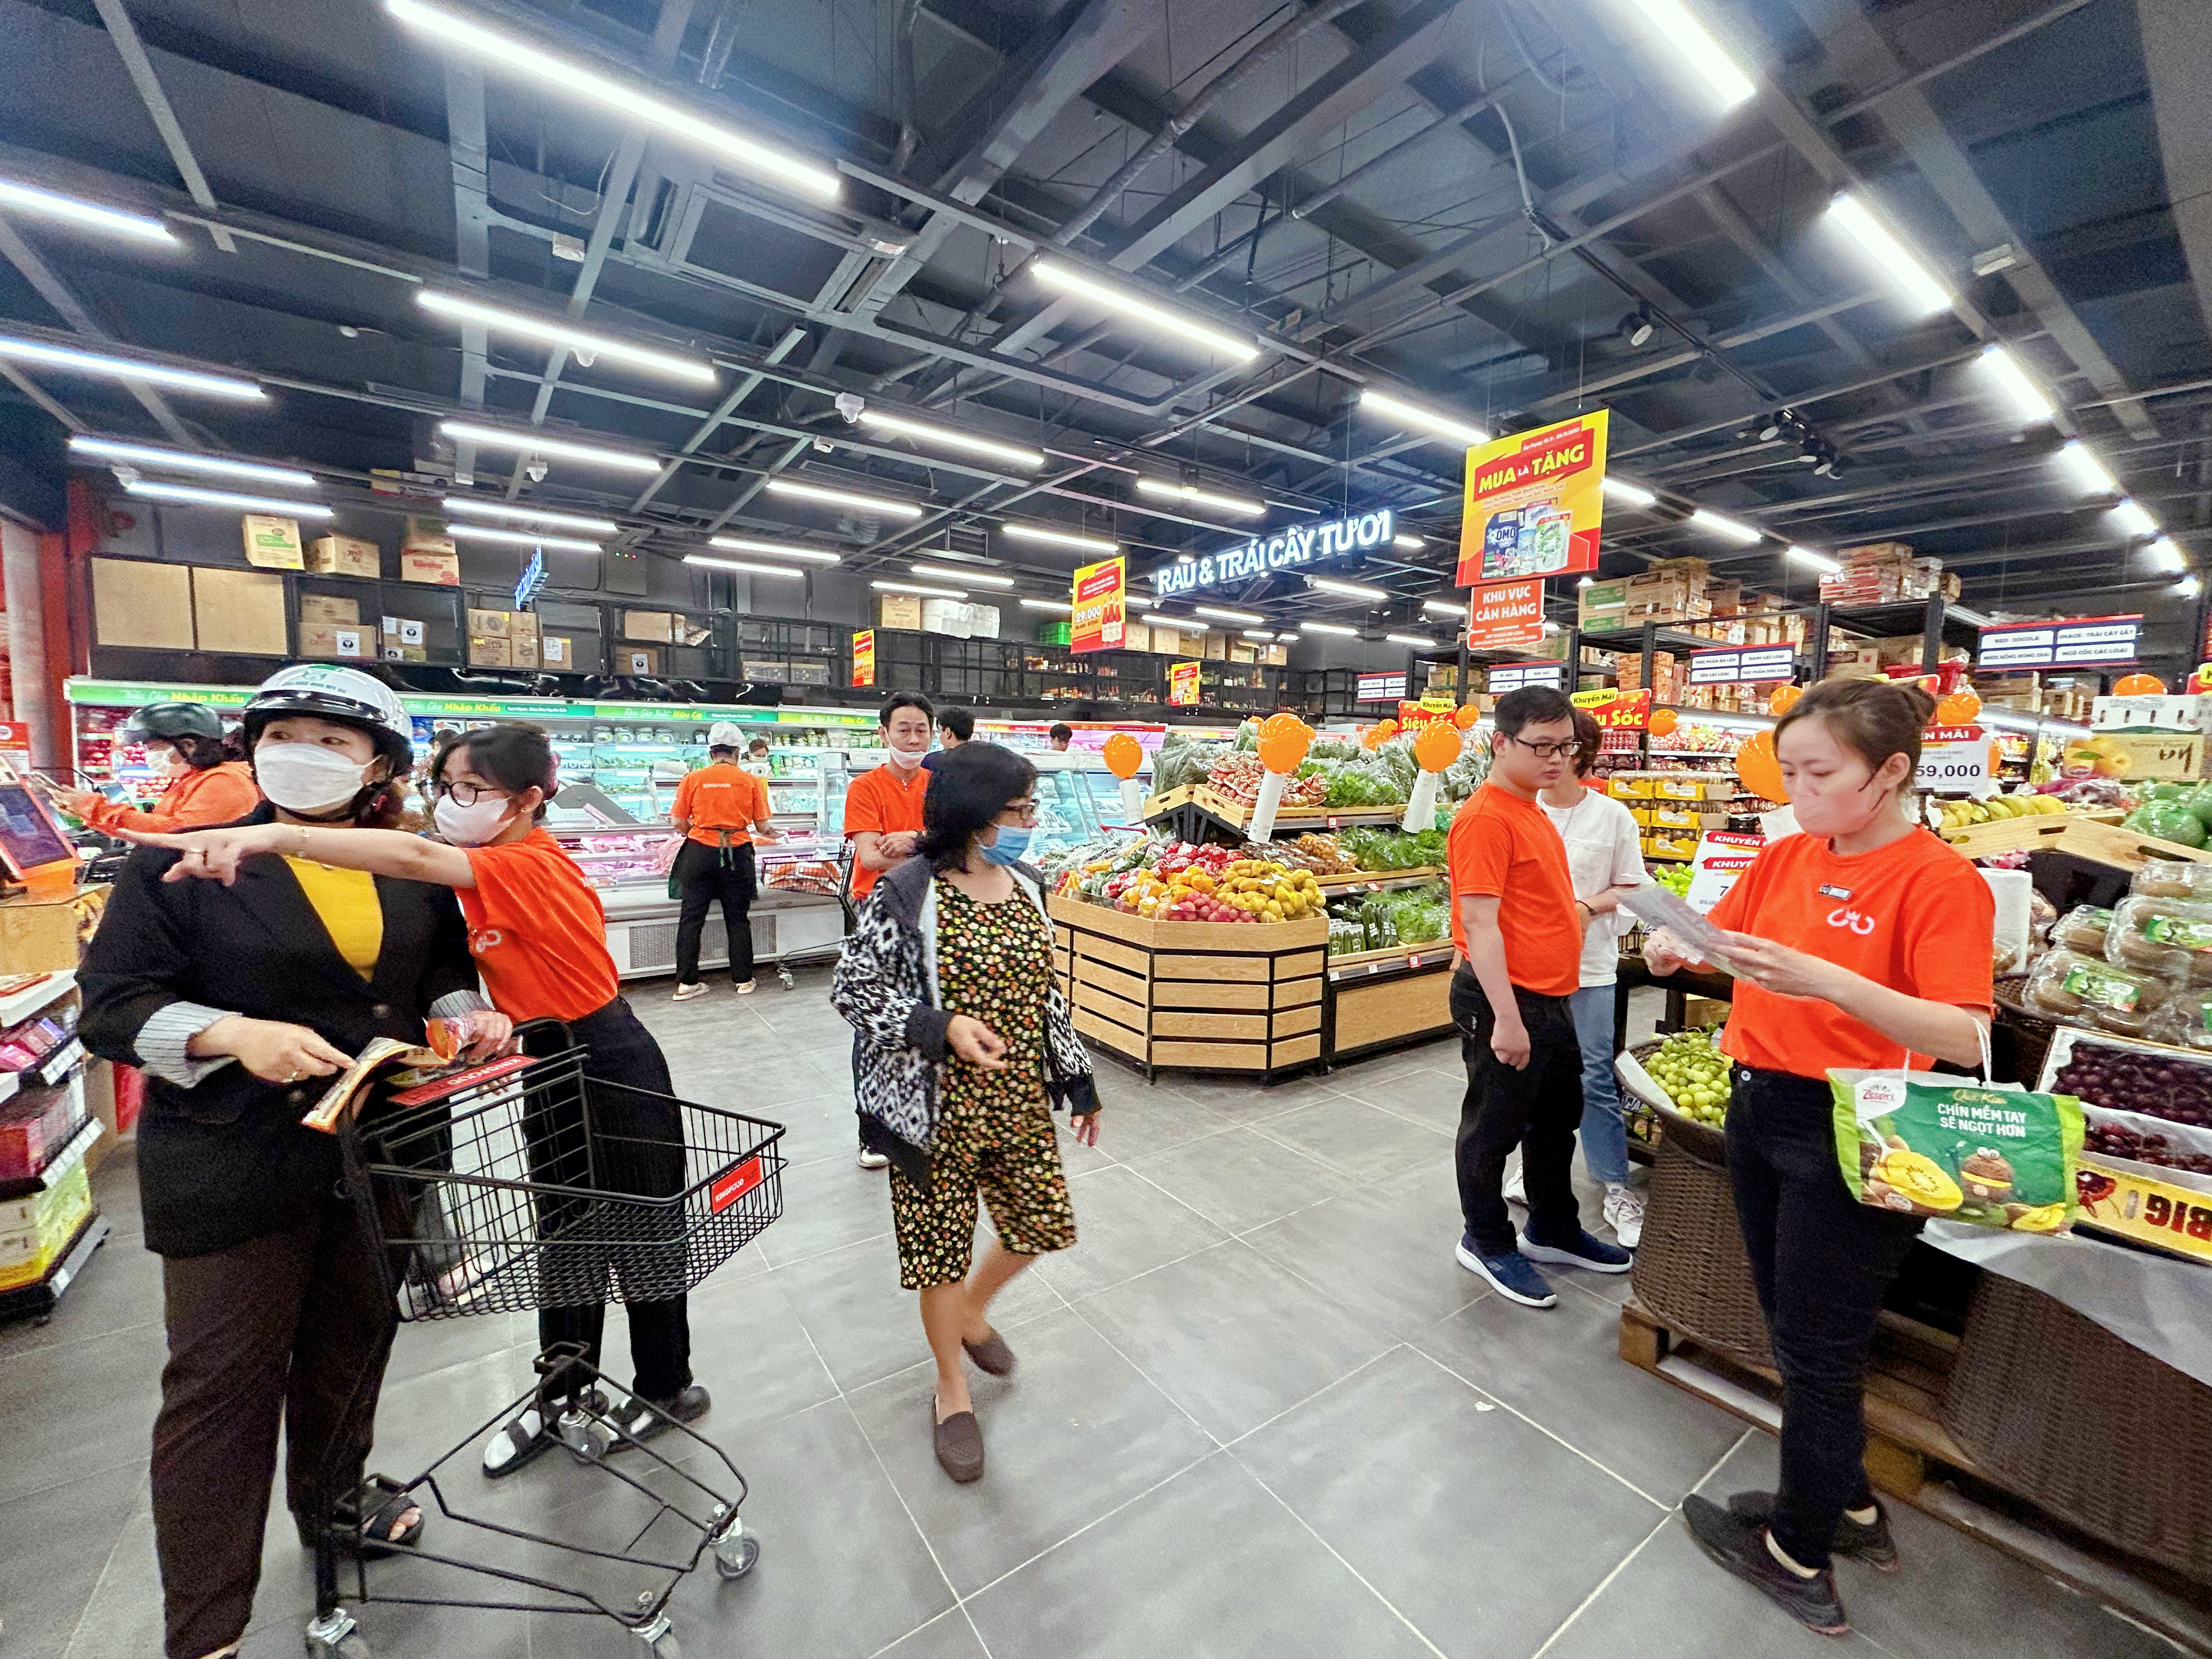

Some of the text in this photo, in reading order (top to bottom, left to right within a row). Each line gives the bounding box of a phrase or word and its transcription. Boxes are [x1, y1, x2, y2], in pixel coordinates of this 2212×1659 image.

[1479, 443, 1584, 494] MUA LÀ TẶNG
[1496, 527, 1516, 540] OMO
[1158, 509, 1392, 595] RAU & TRÁI CÂY TƯƠI
[1483, 585, 1531, 604] KHU VỰC
[1075, 605, 1102, 624] 29.000
[1475, 602, 1537, 622] CÂN HÀNG
[170, 692, 208, 704] Nhập
[211, 692, 245, 703] Khẩu
[1574, 693, 1600, 704] Khuyến
[444, 702, 473, 712] Nhập
[475, 703, 501, 712] Khẩu
[673, 710, 690, 718] Hữu
[691, 711, 703, 719] Cơ
[1401, 716, 1427, 730] Siêu
[1611, 707, 1643, 726] Sốc
[1939, 728, 1970, 739] MÃI
[1714, 835, 1760, 847] KHUYẾN
[1862, 1089, 1895, 1102] Zespri
[1937, 1103, 2027, 1124] CHÍN MỀM TAY
[1939, 1116, 2026, 1138] SẼ NGỌT HƠN
[715, 1178, 744, 1203] KINGFOOD
